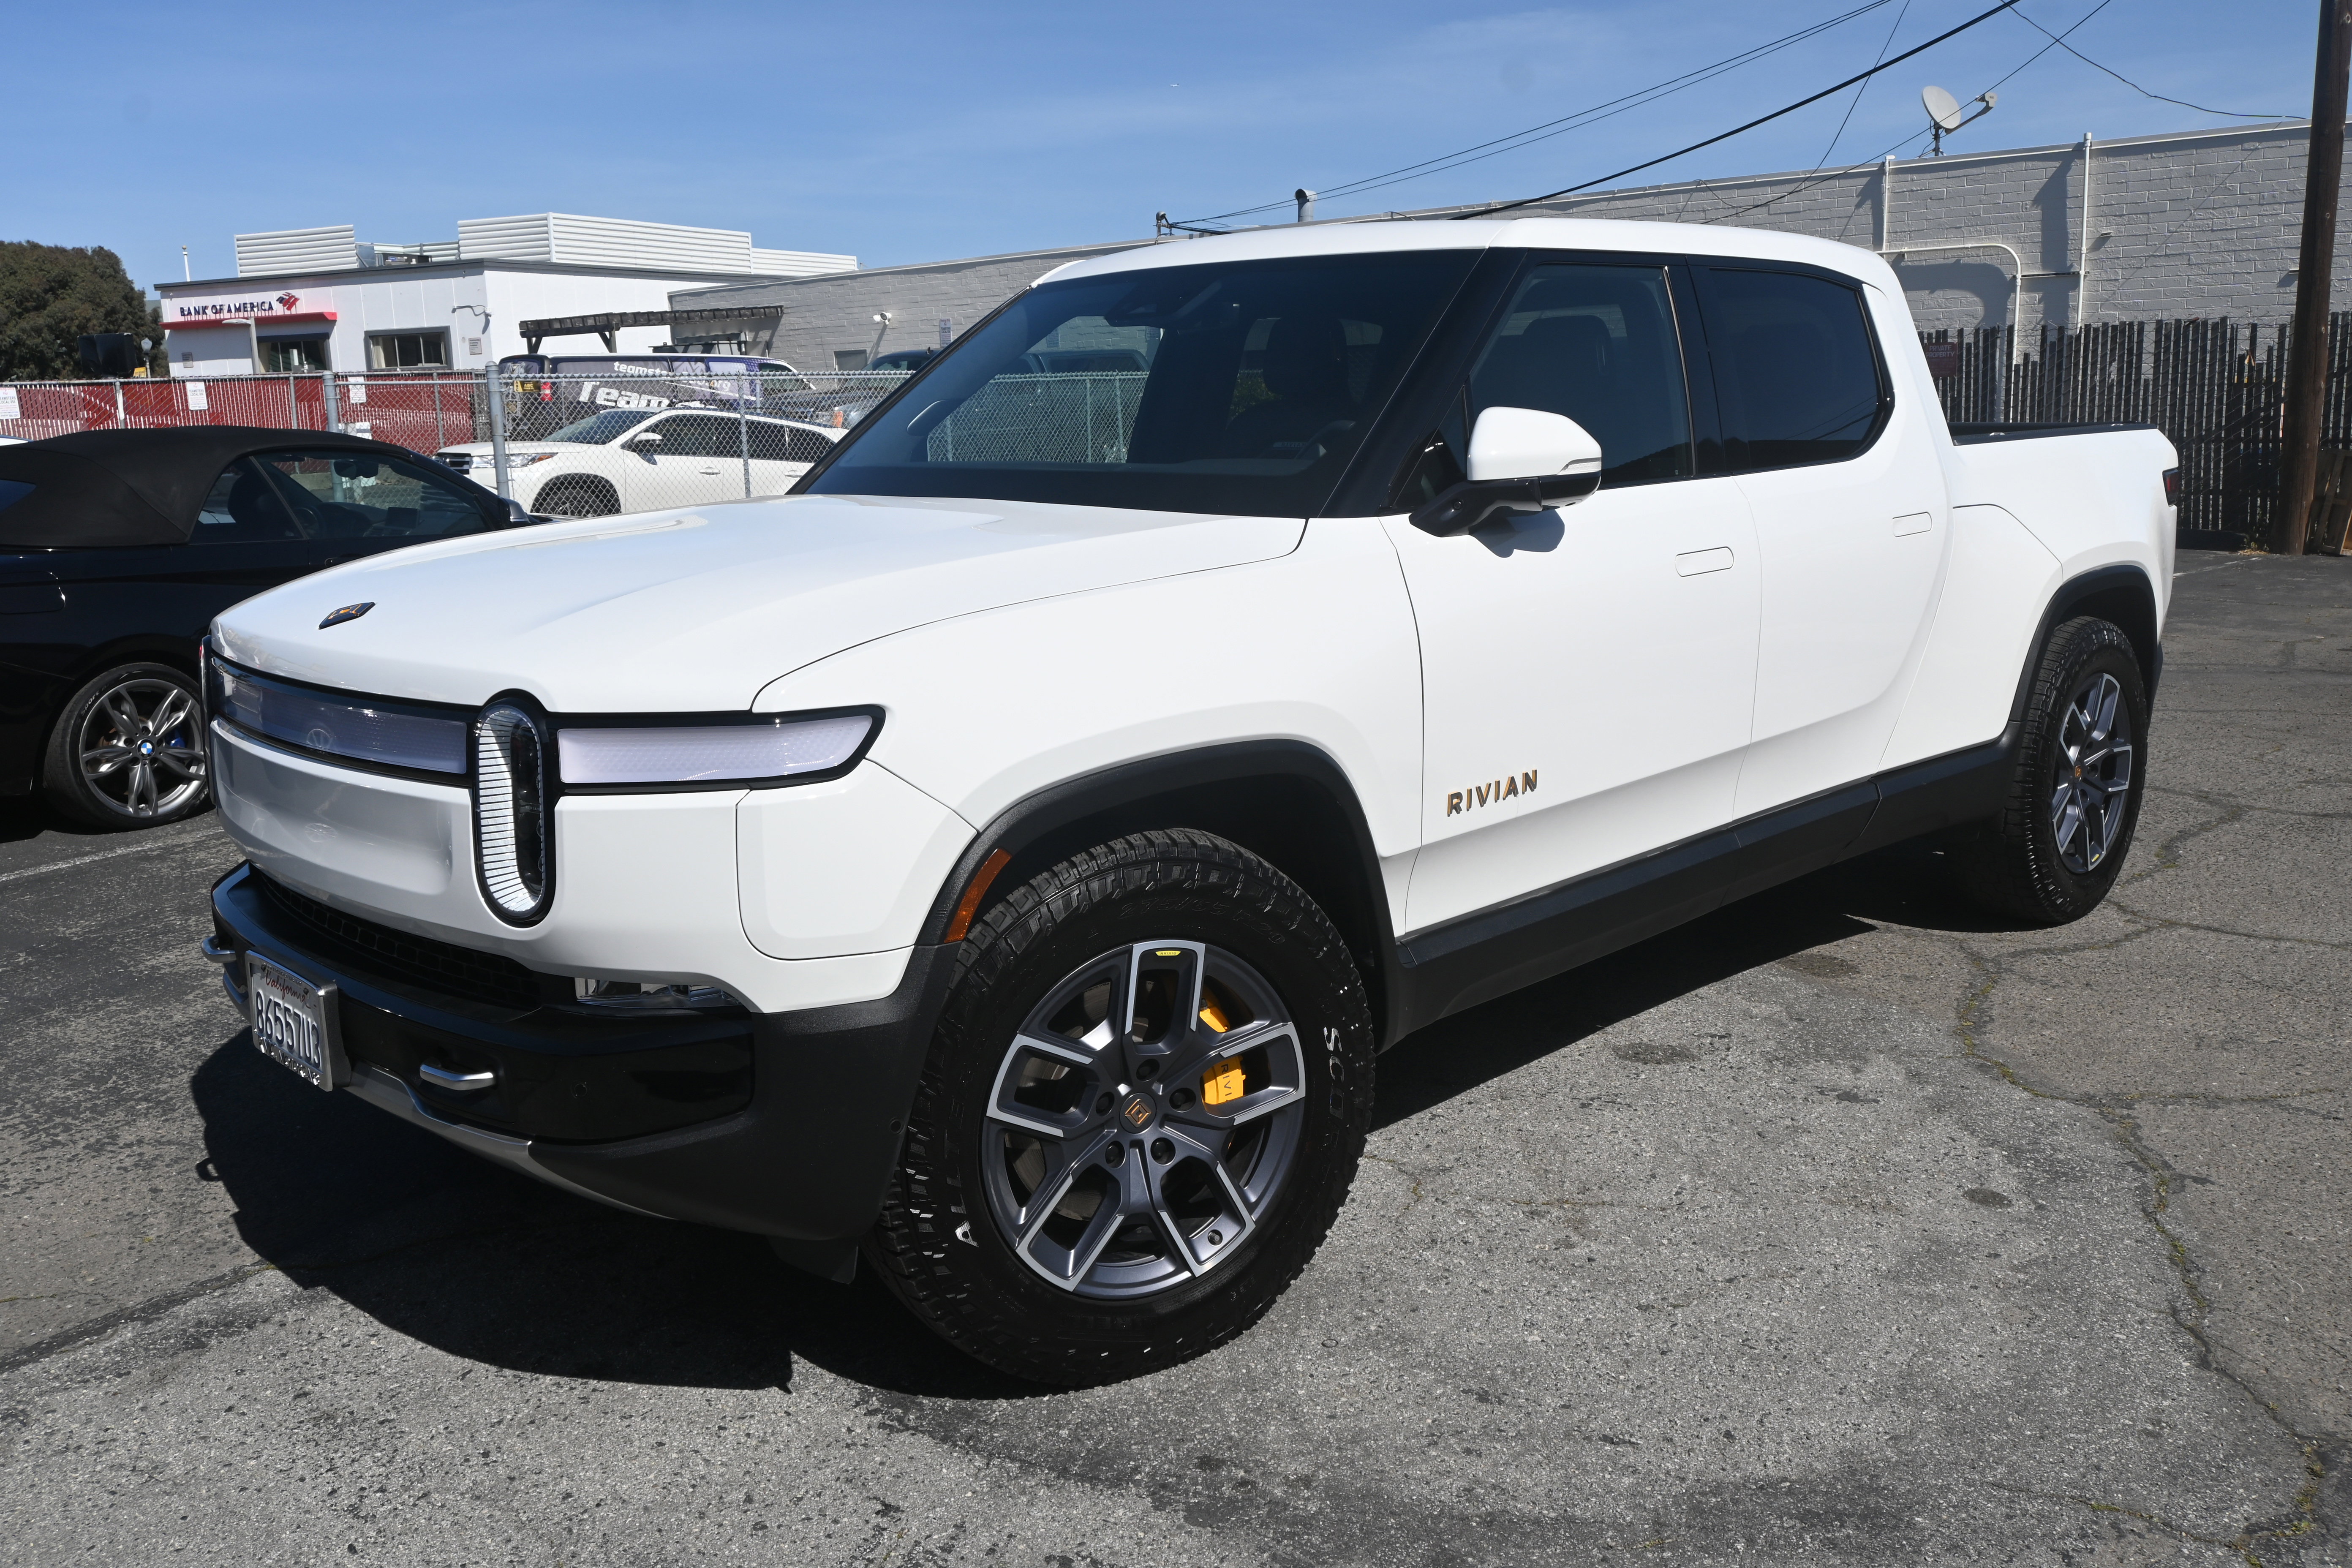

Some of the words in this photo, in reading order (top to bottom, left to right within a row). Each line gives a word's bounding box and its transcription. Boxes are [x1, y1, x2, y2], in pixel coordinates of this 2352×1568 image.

[180, 305, 208, 316] BANK
[211, 304, 223, 314] OF
[227, 301, 274, 313] AMERICA
[1446, 768, 1538, 817] RIVIAN
[265, 969, 311, 1009] California
[256, 991, 321, 1069] 86557U3
[1220, 1063, 1233, 1097] RIVI
